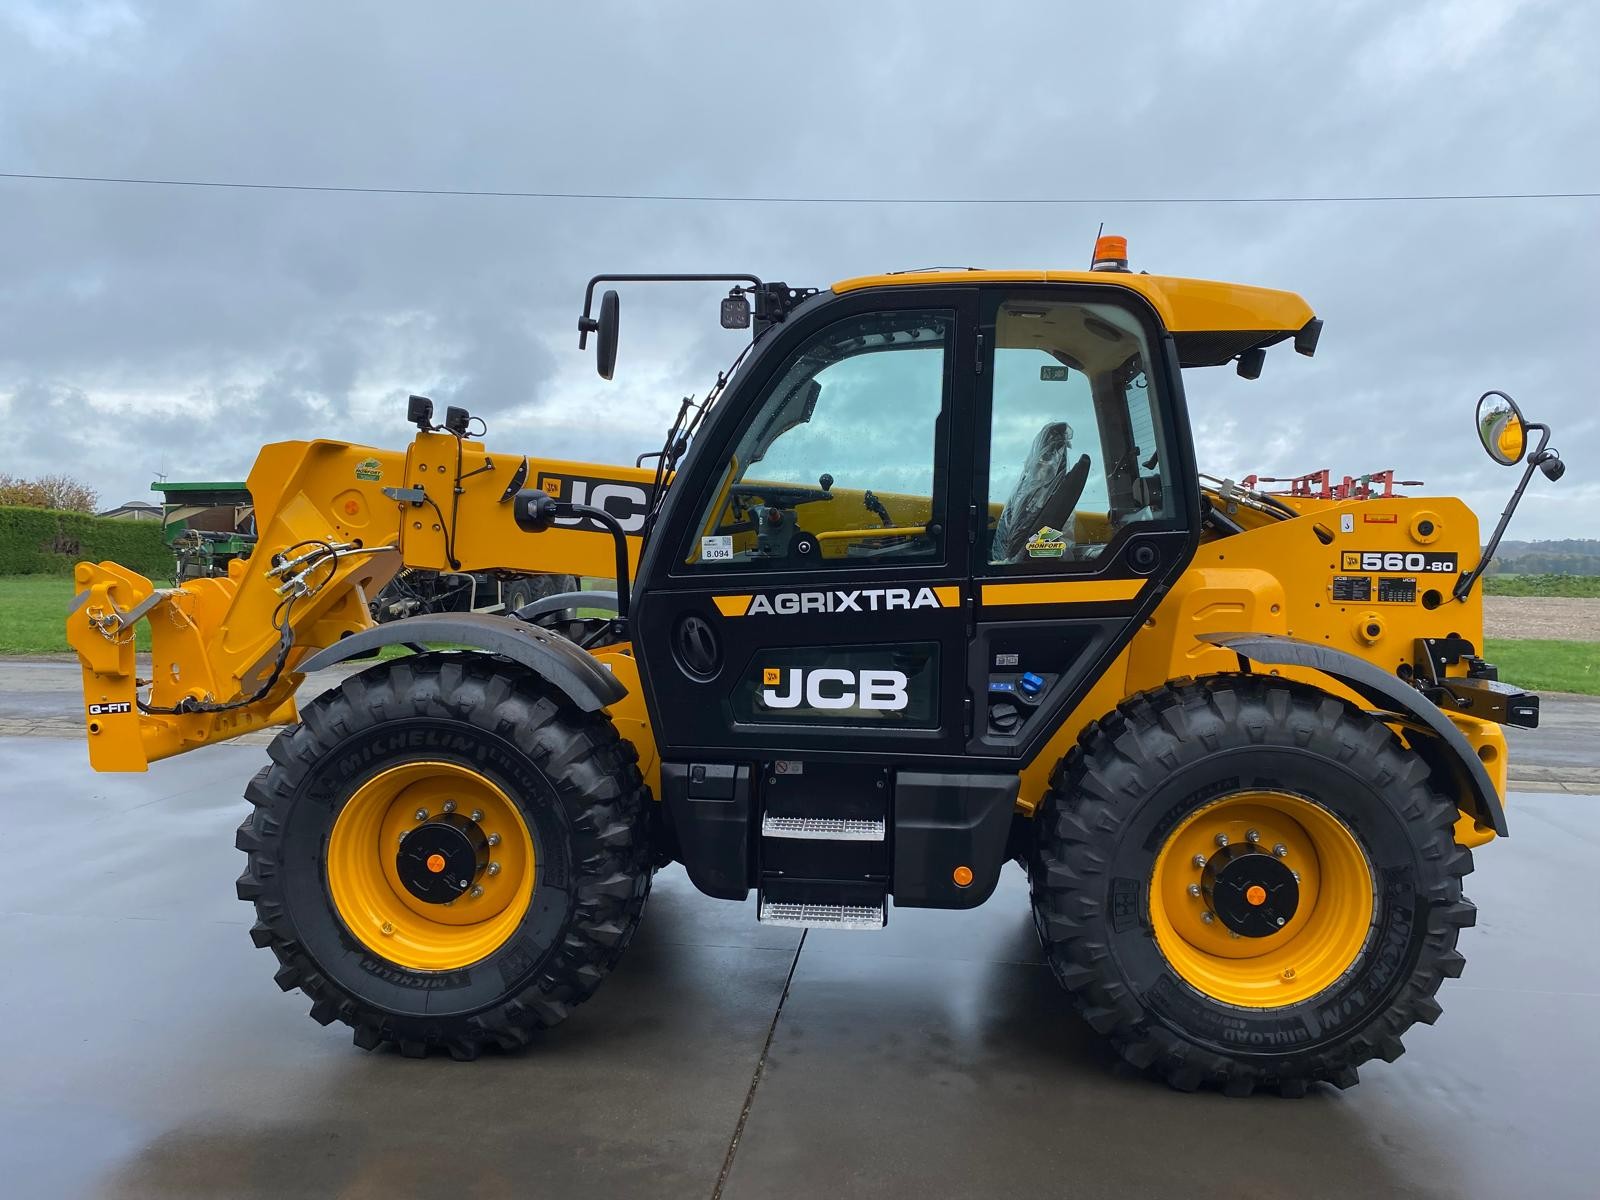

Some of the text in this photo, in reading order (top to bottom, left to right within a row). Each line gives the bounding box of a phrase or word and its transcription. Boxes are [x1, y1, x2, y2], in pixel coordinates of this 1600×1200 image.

[553, 480, 647, 533] JC
[706, 550, 729, 558] 8.094
[1362, 553, 1453, 571] 560-80
[748, 587, 939, 616] AGRIXTRA
[763, 668, 908, 710] JCB
[90, 703, 130, 714] Q-FIT
[340, 730, 475, 776] MICHELIN
[363, 960, 447, 988] MICHELIN
